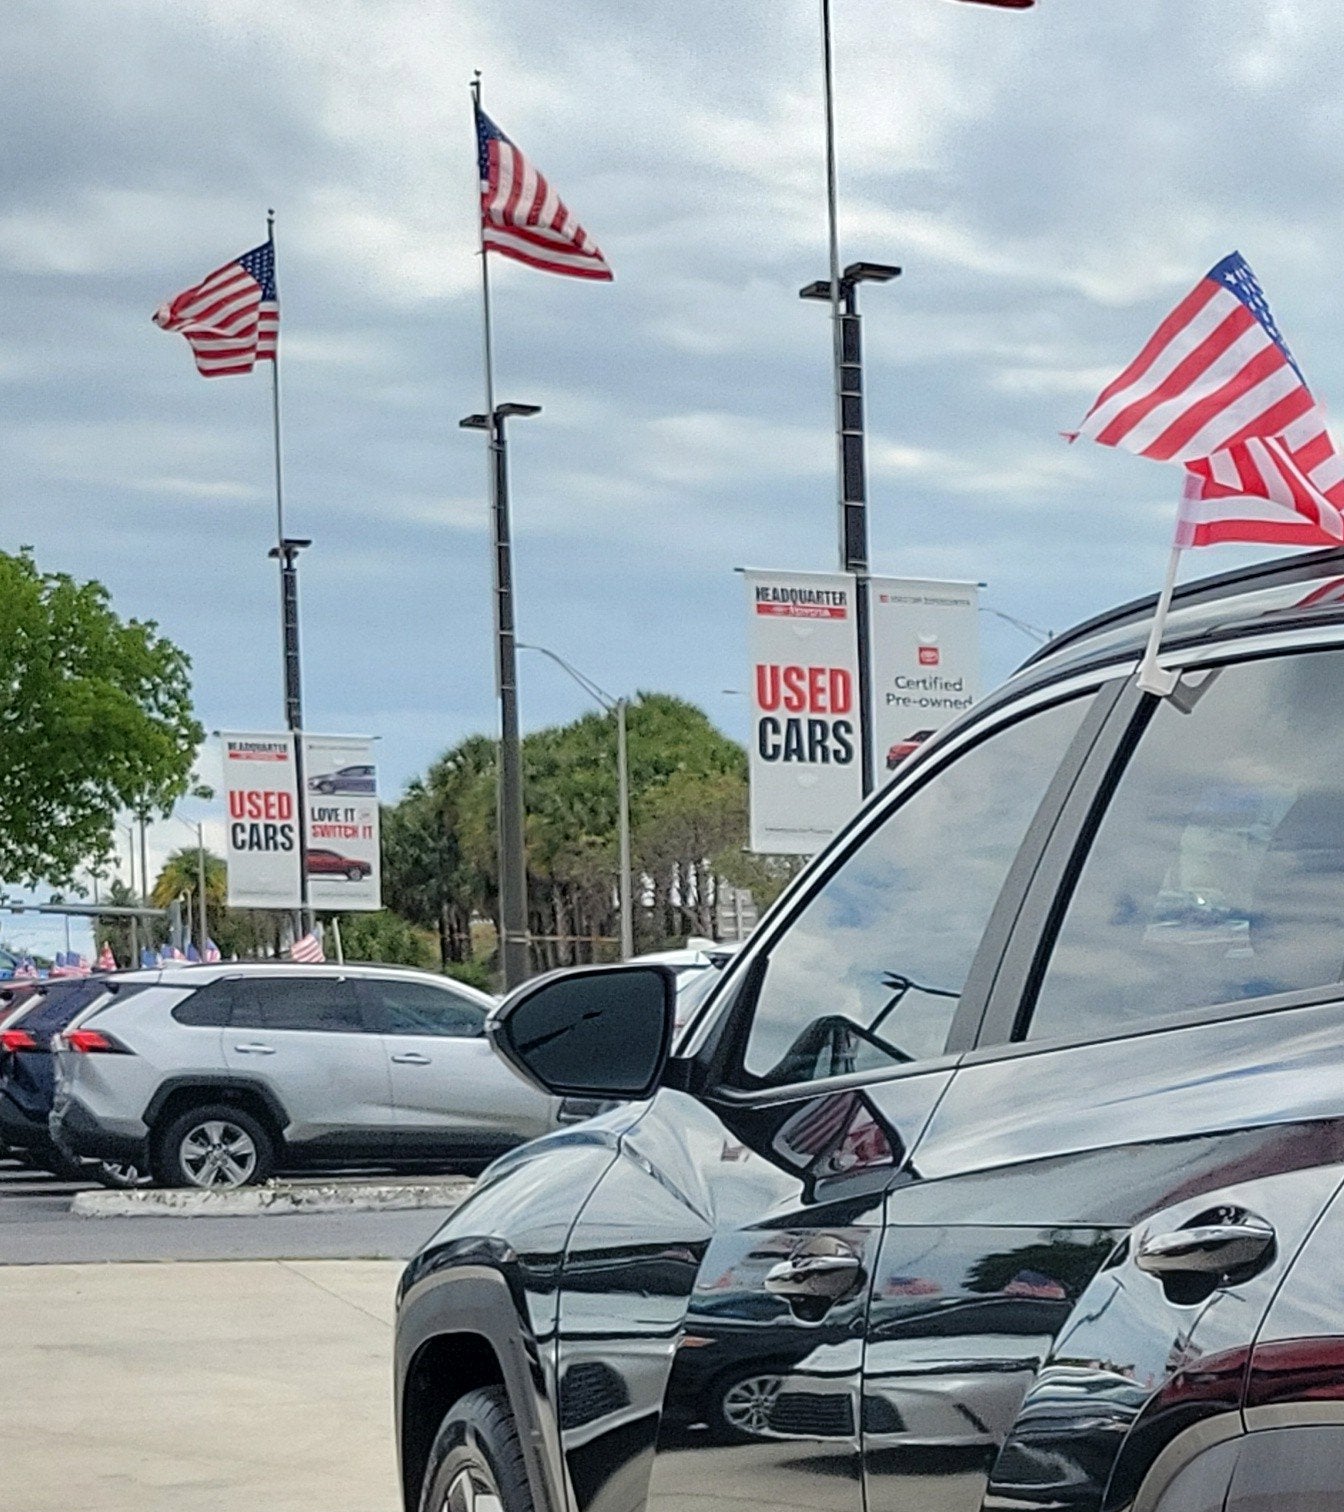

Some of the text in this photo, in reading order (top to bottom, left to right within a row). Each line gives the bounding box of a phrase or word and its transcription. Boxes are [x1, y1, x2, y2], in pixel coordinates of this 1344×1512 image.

[755, 585, 848, 607] HEADQUARTER
[755, 664, 853, 714] USED
[894, 675, 963, 692] Certified
[885, 692, 973, 709] Pre-owned
[757, 716, 855, 765] CARS
[228, 790, 293, 820] USED
[310, 807, 340, 822] LOVE
[344, 807, 355, 822] IT
[230, 822, 294, 852] CARS
[312, 824, 373, 840] SWITCH IT
